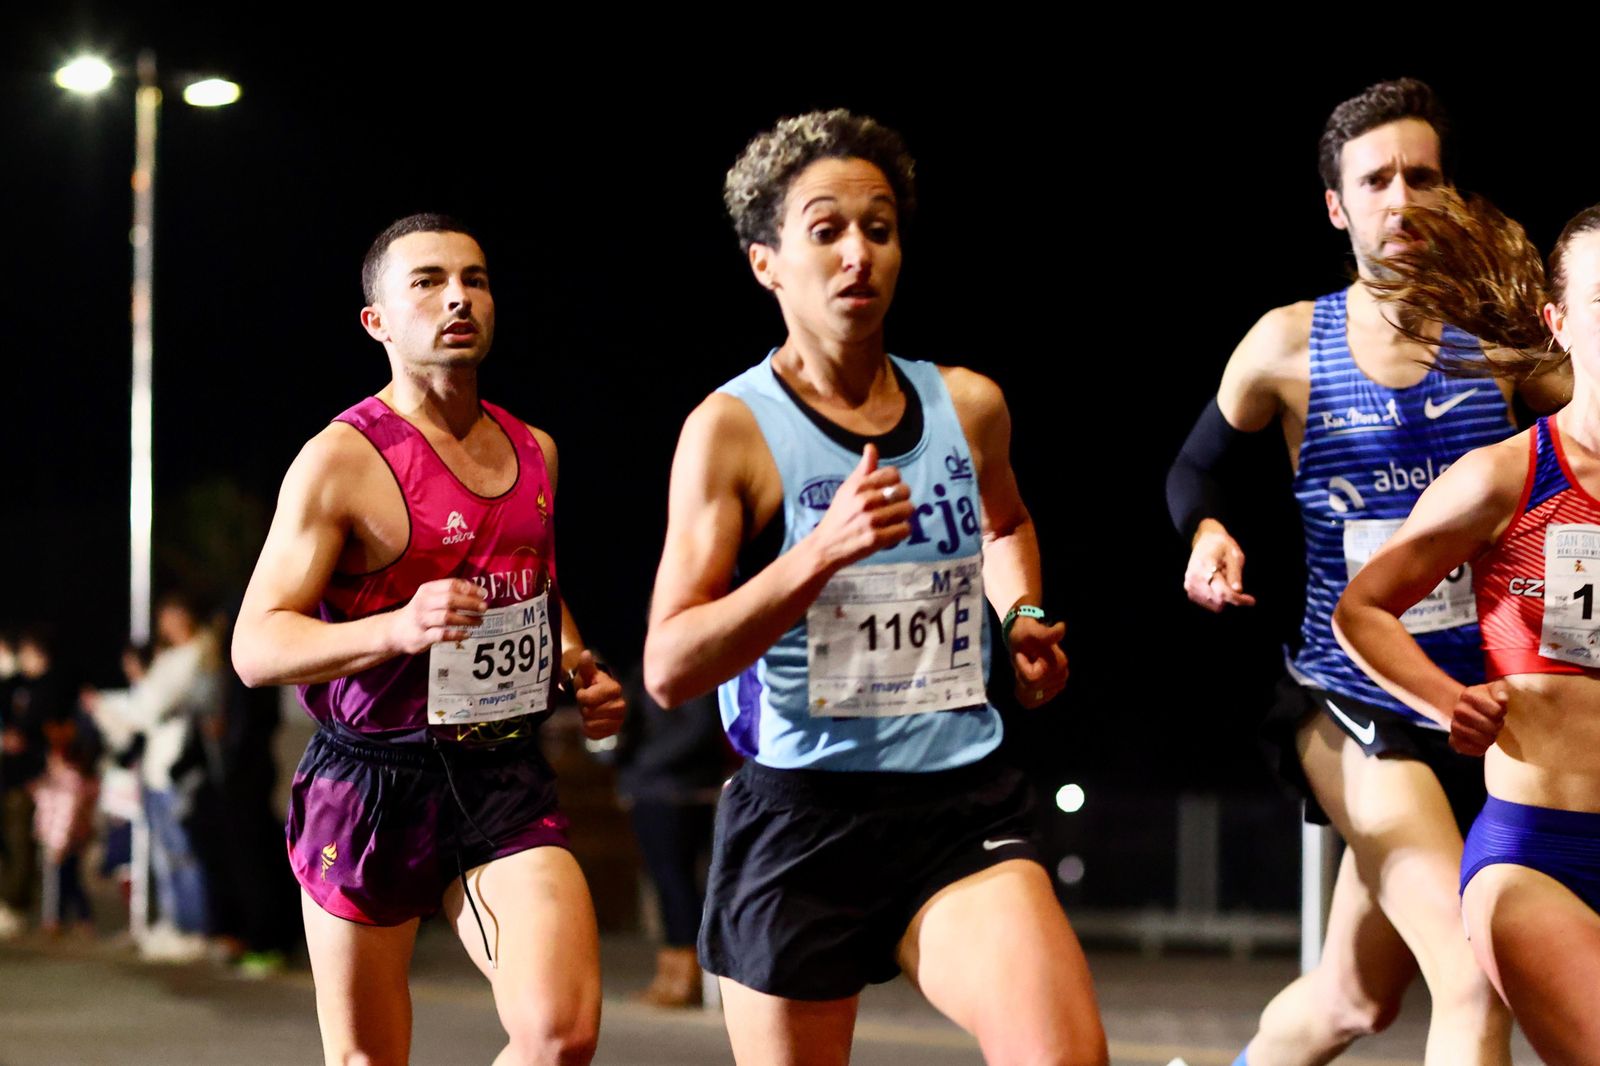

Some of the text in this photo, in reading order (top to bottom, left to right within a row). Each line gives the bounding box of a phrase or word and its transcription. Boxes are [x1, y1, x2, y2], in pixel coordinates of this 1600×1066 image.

[1373, 457, 1451, 493] abel
[1573, 583, 1594, 620] 1
[858, 608, 945, 651] 1161
[472, 634, 535, 680] 539
[479, 689, 518, 707] mayoral
[870, 676, 927, 695] mayoral
